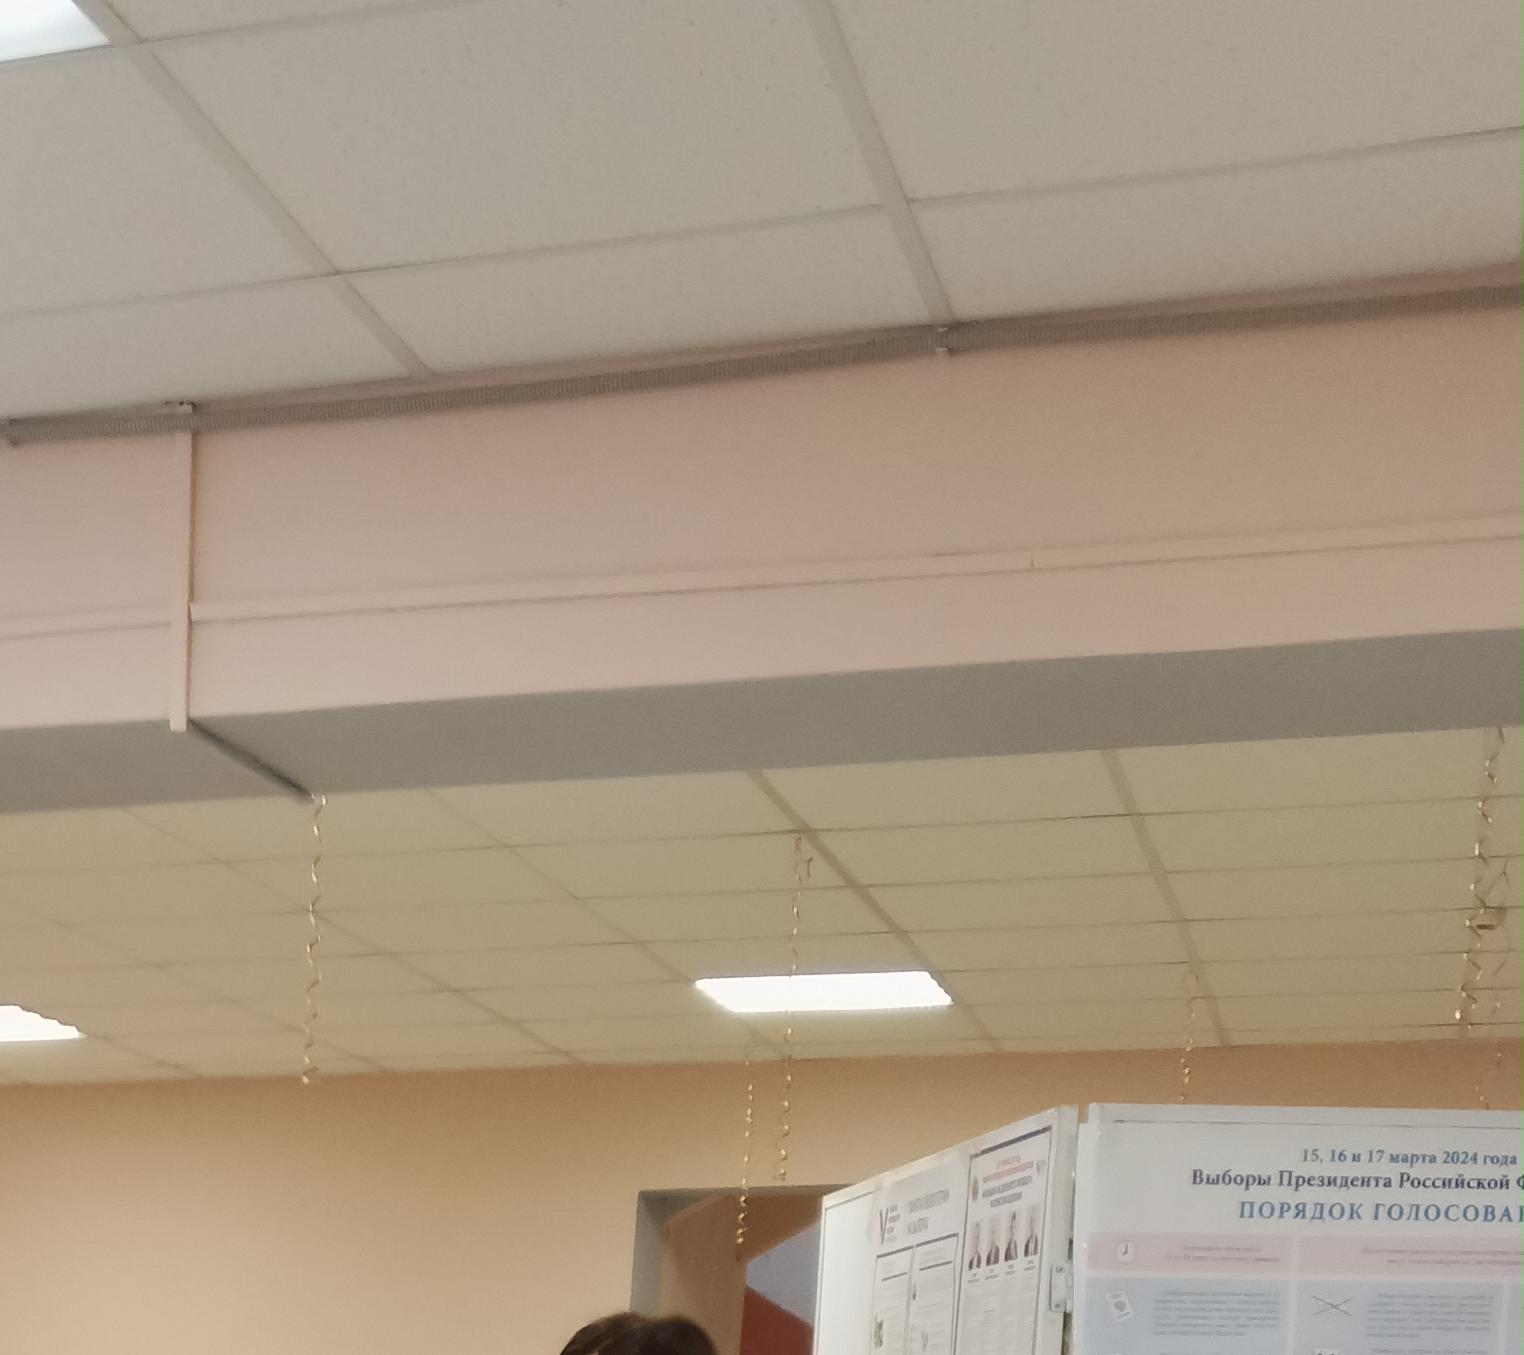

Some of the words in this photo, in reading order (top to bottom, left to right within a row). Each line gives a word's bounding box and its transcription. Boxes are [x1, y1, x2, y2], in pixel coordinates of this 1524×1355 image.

[1302, 1149, 1324, 1164] 15,
[1330, 1149, 1347, 1163] 16
[1352, 1153, 1362, 1163] и
[1368, 1150, 1385, 1164] 17
[1389, 1153, 1437, 1168] марта
[1442, 1151, 1478, 1165] 2024
[1483, 1154, 1517, 1167] года
[1192, 1169, 1271, 1191] Выборы
[1278, 1170, 1392, 1191] Президента
[1399, 1172, 1510, 1190] Российской
[1239, 1201, 1364, 1222] ПОРЯДОК
